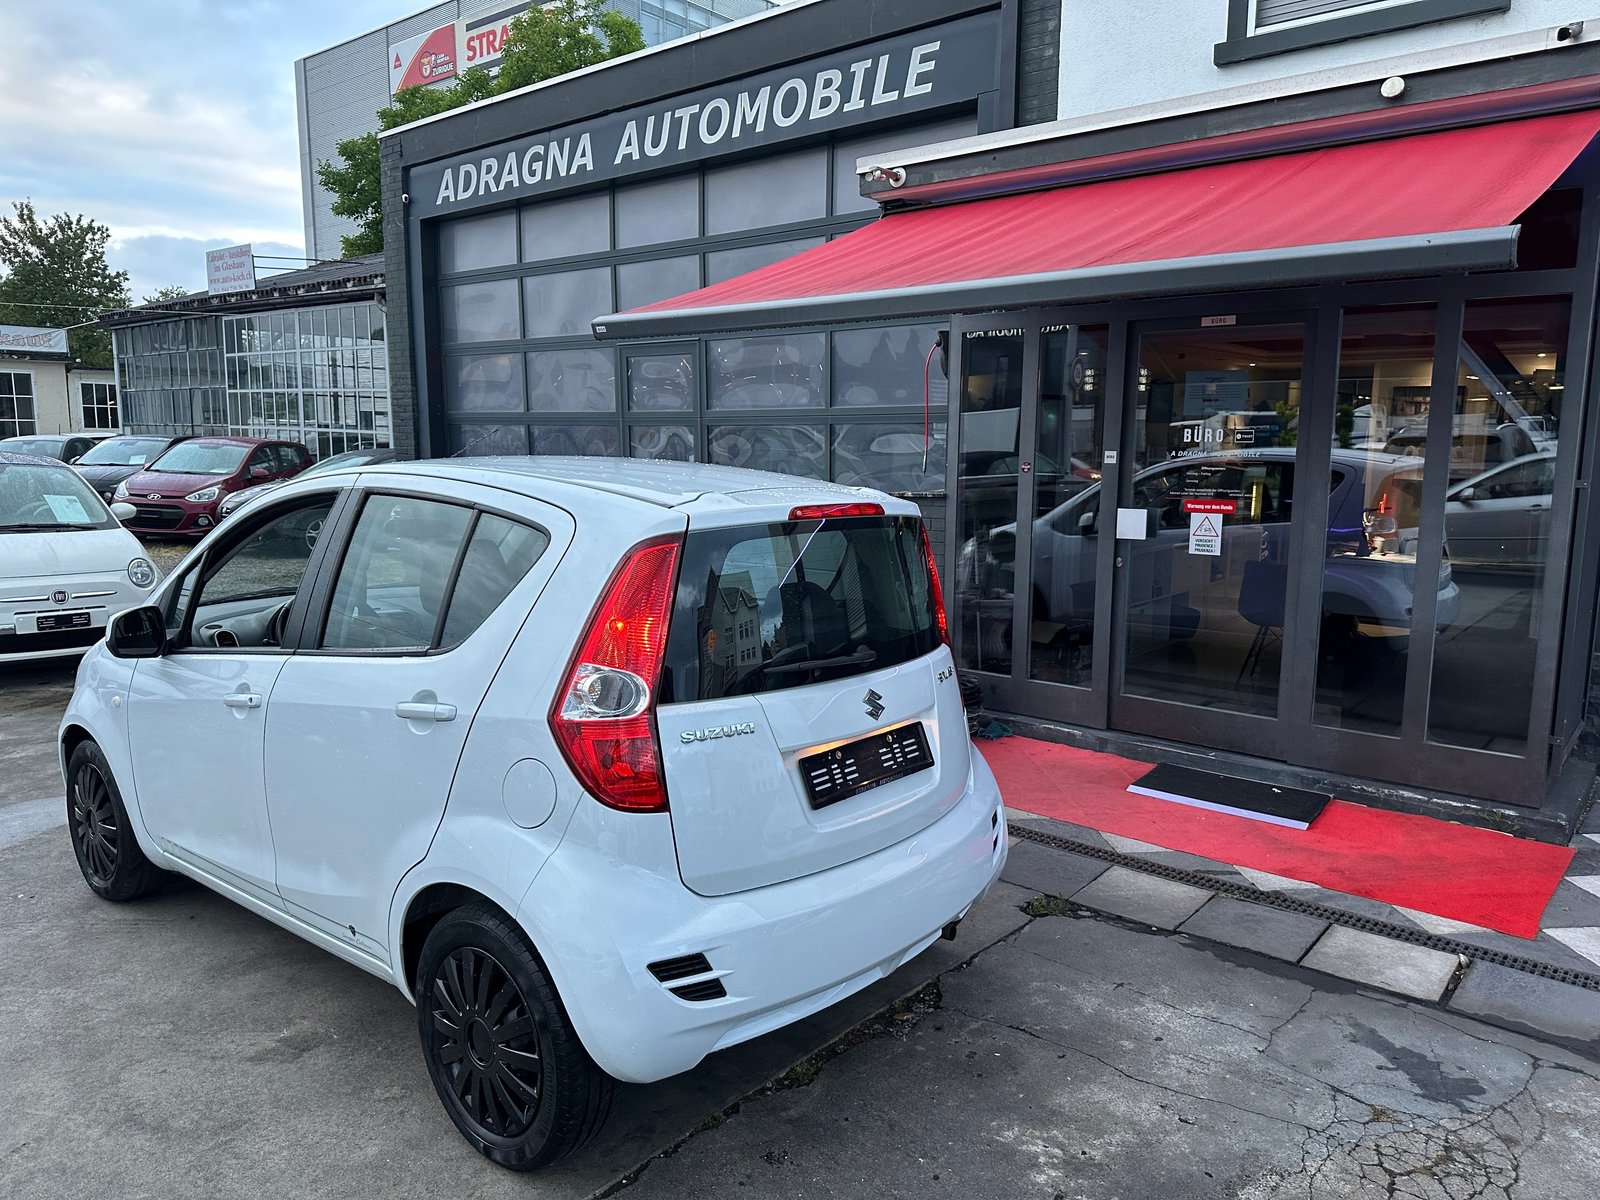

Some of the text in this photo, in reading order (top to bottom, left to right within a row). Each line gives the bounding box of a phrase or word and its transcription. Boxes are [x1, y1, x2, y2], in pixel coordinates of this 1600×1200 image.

[432, 62, 454, 76] ZURIQUE
[436, 40, 941, 204] ADRAGNA AUTOMOBILE
[1183, 426, 1224, 443] BÜRO
[680, 721, 755, 744] SUZUKI
